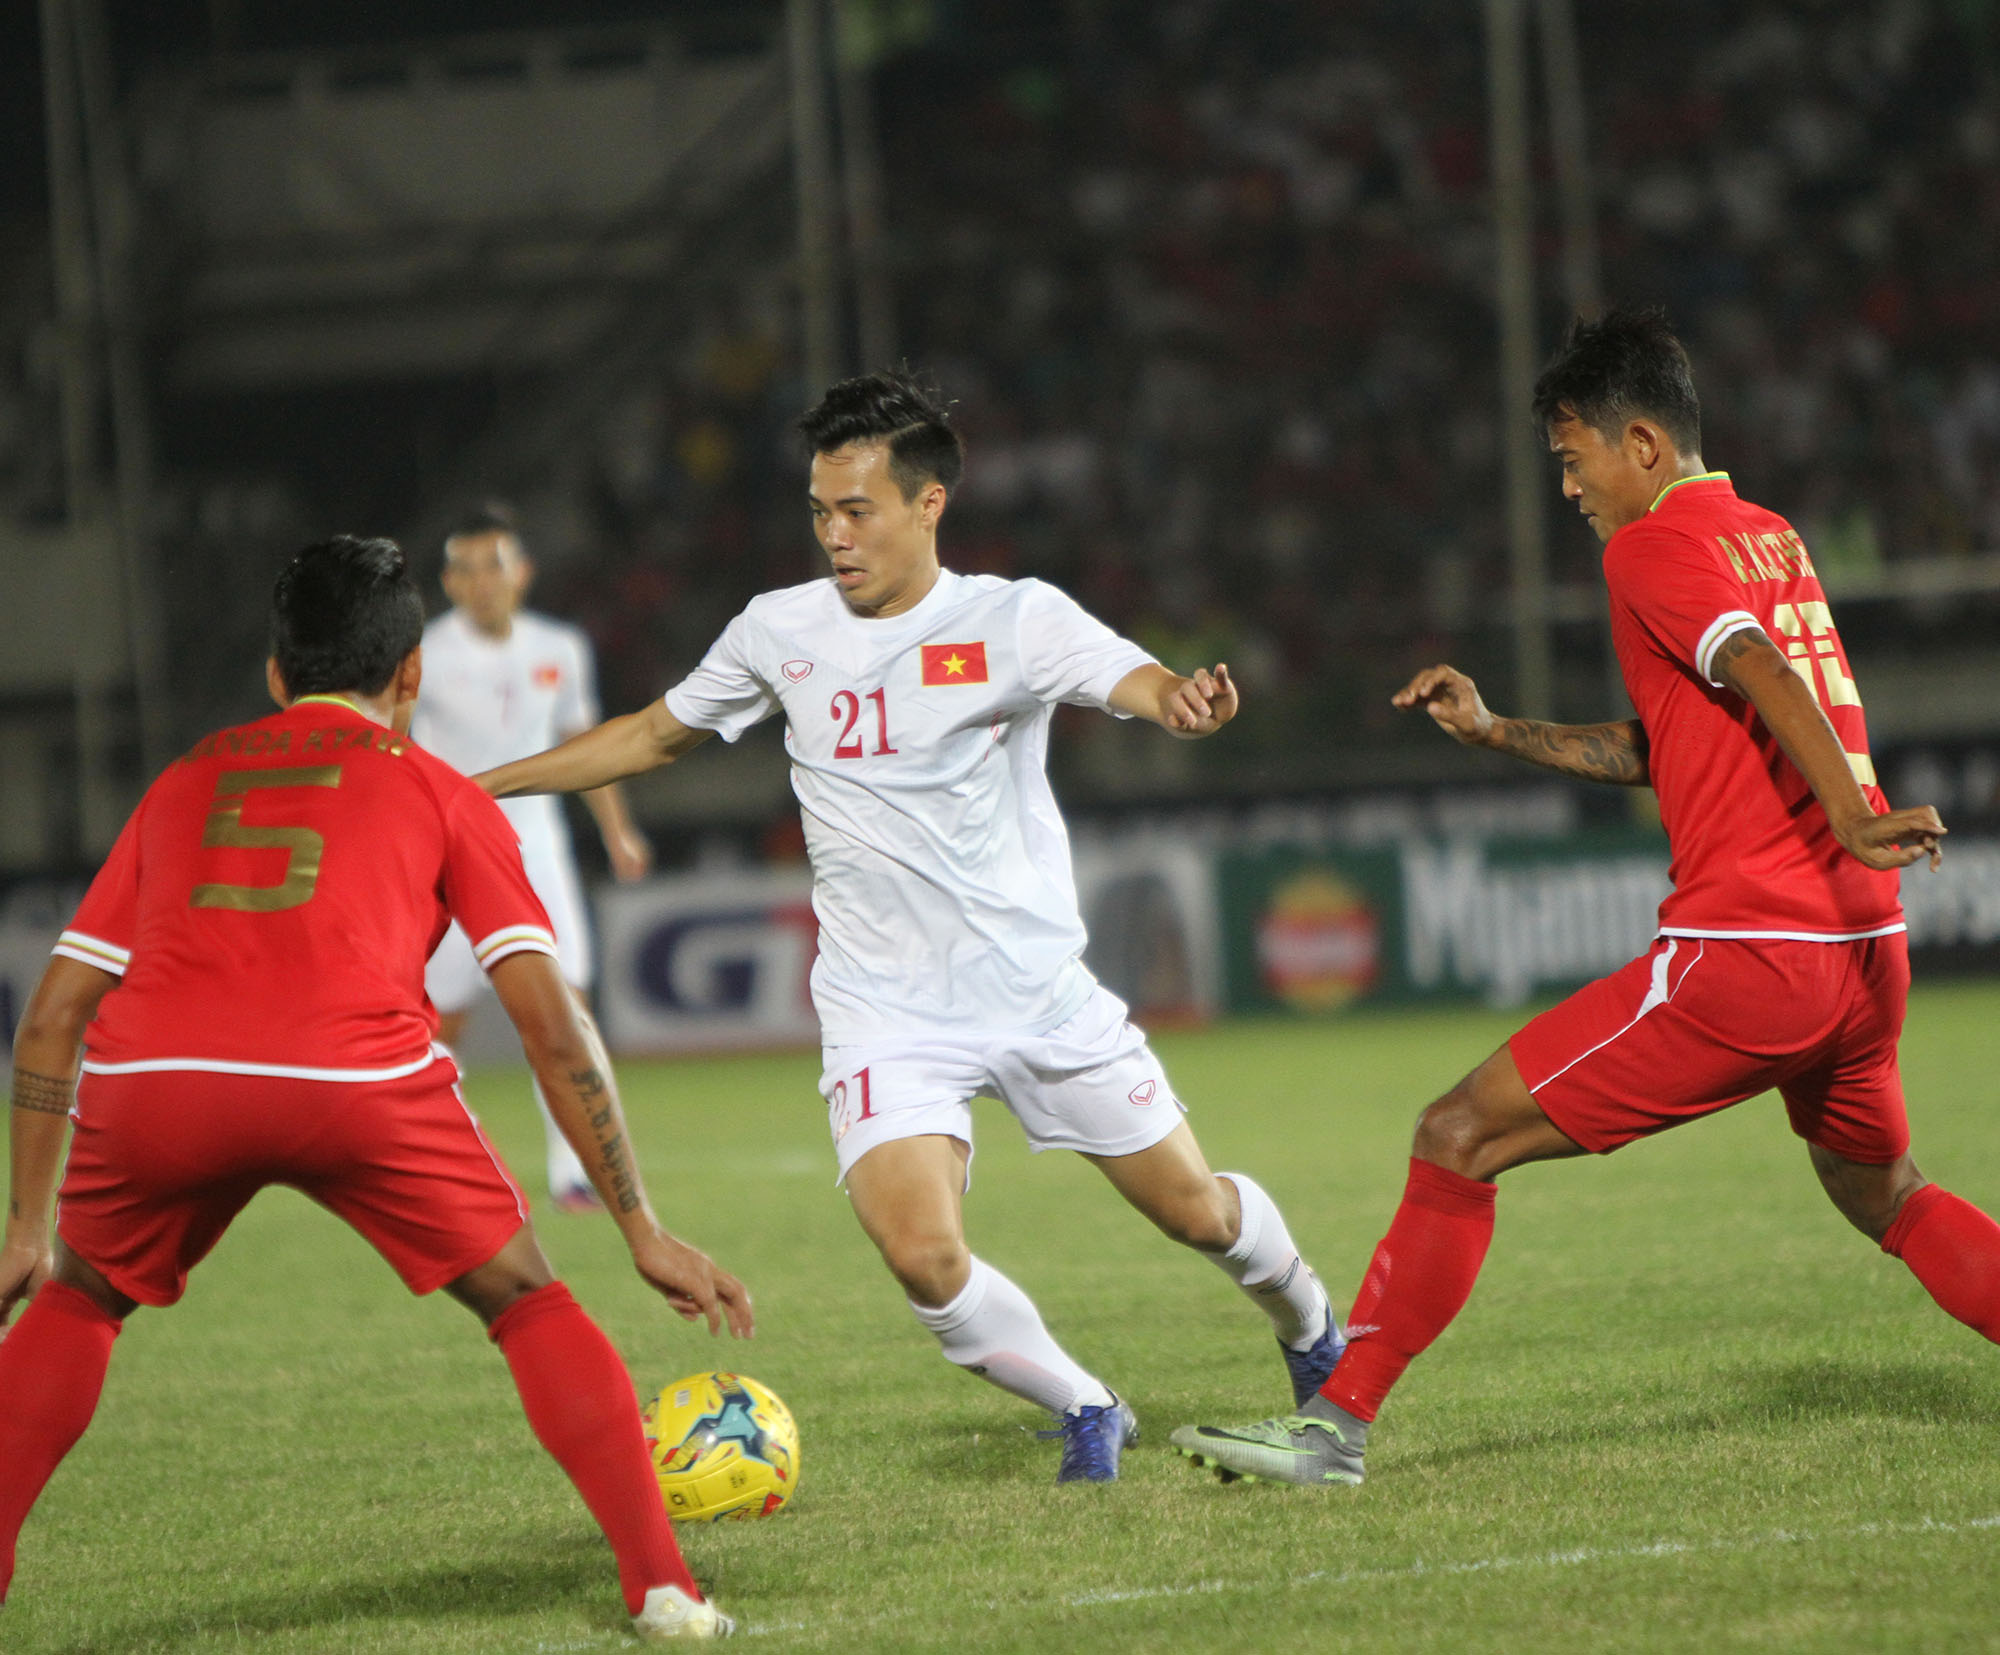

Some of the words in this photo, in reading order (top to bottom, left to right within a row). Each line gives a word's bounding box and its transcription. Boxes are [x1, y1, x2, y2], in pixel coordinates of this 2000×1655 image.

[830, 686, 899, 760] 21
[188, 764, 343, 914] 5
[833, 1066, 880, 1142] 21
